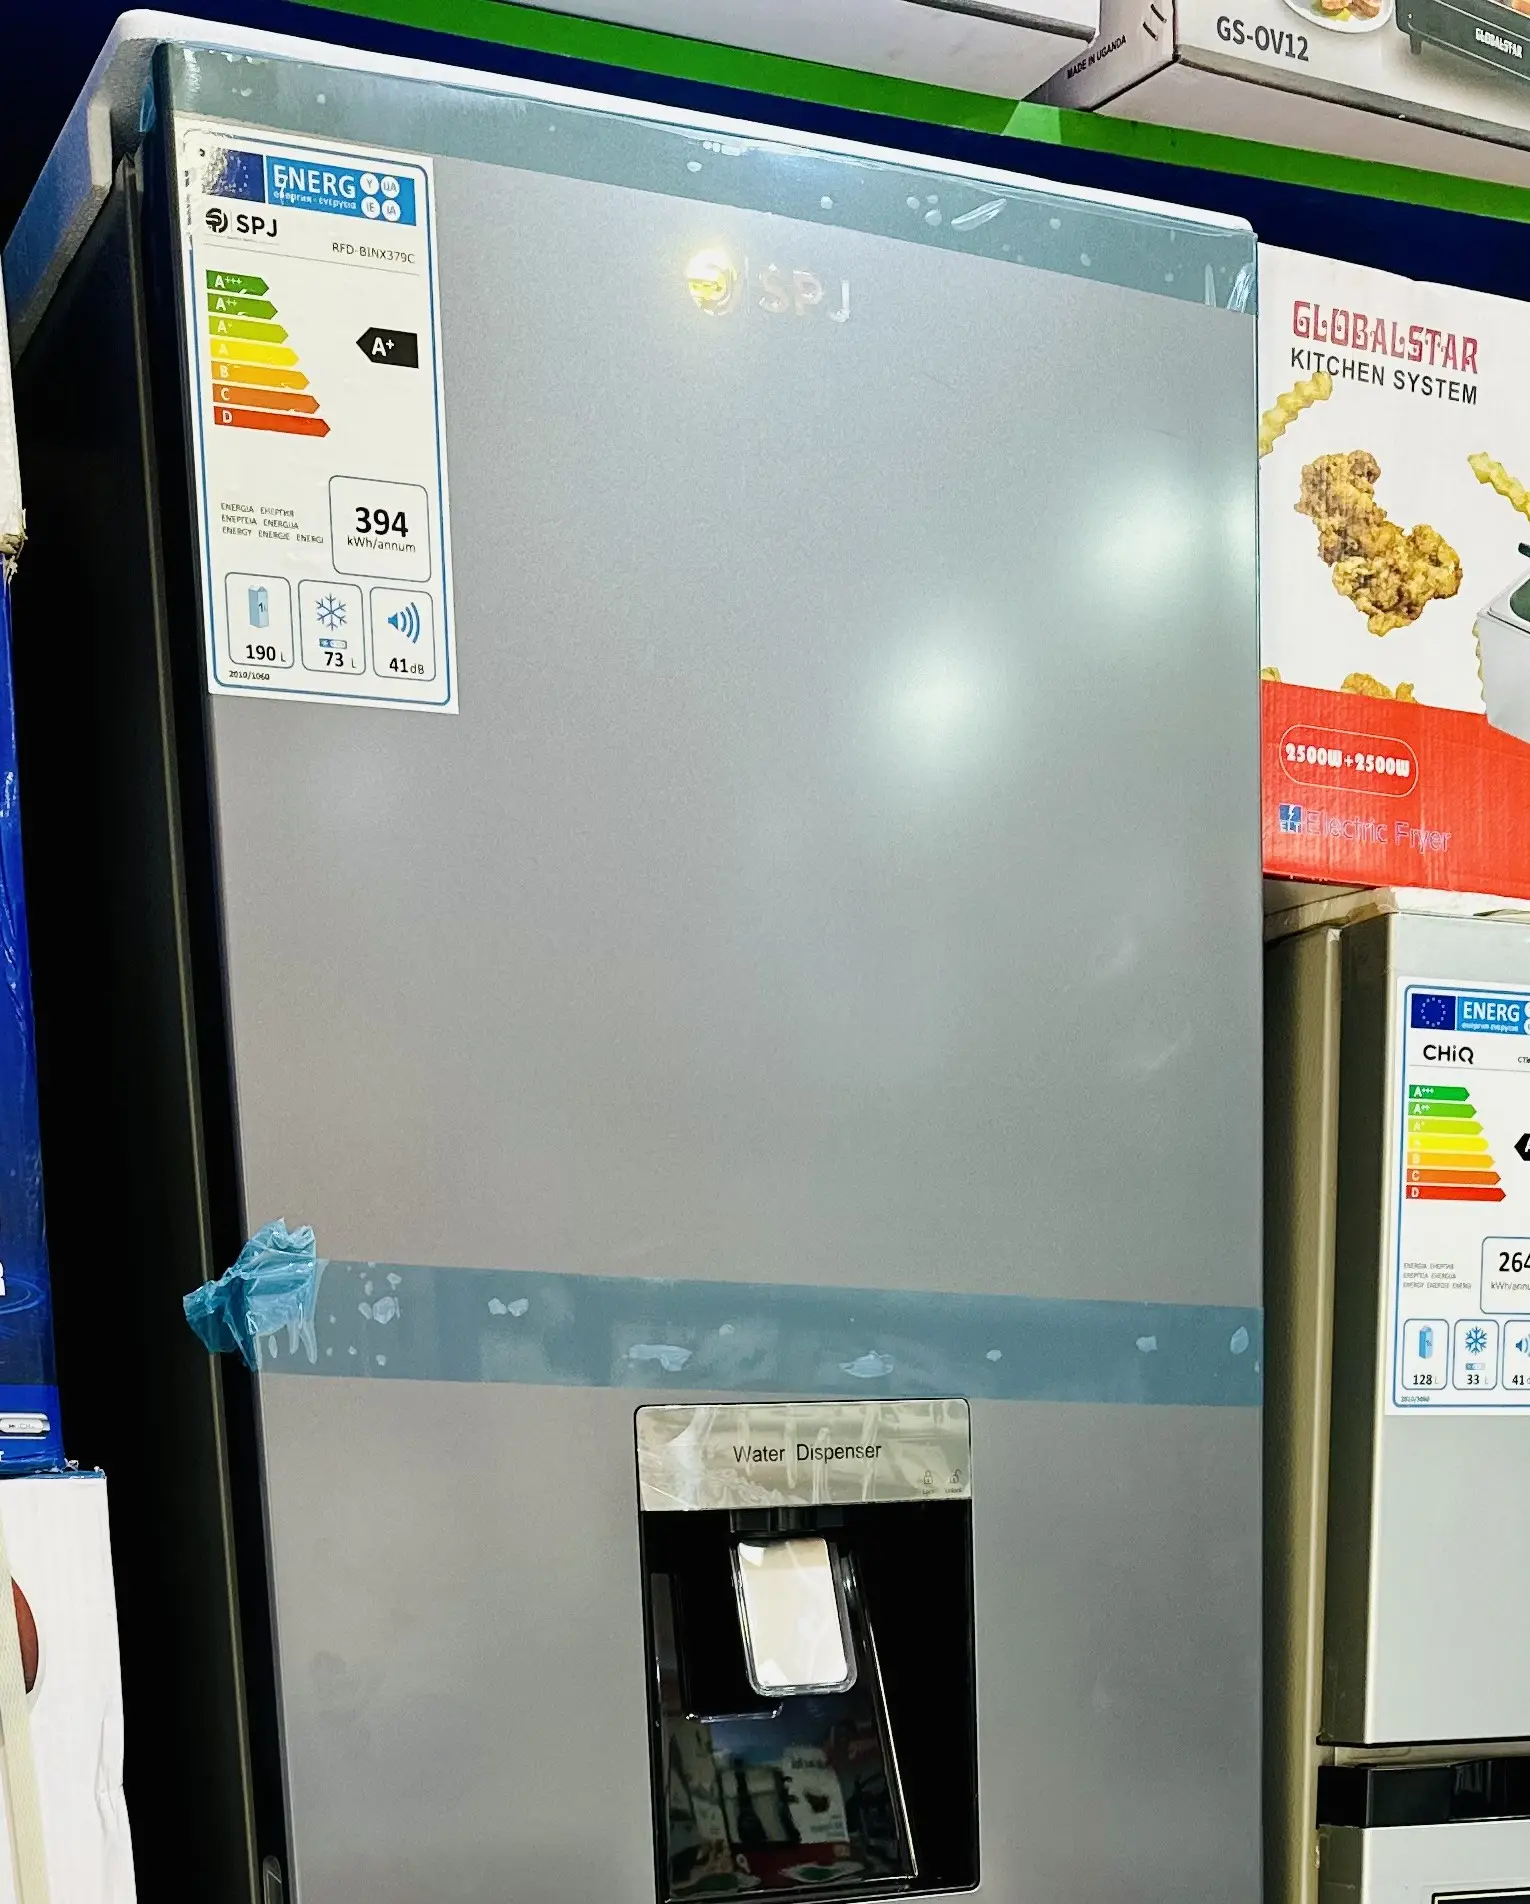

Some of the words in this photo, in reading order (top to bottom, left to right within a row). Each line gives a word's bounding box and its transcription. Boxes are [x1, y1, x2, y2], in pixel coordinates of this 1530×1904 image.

[1216, 15, 1309, 62] GS-OV12
[1066, 59, 1087, 79] MADE
[1087, 53, 1096, 67] IN
[1096, 34, 1127, 61] UGANDA
[272, 164, 356, 199] ENERG
[236, 213, 278, 238] SPJ
[332, 242, 416, 265] RFD-BINX379C
[371, 336, 395, 357] A+
[1292, 300, 1479, 375] GLOBALSTAR
[219, 364, 229, 379] B
[1291, 347, 1385, 387] KITCHEN
[1393, 370, 1478, 405] SYSTEM
[220, 387, 230, 401] C
[222, 409, 233, 424] D
[355, 506, 409, 538] 394
[347, 535, 416, 553] kWh/annum
[245, 644, 277, 662] 190
[323, 650, 345, 668] 73
[1285, 742, 1410, 778] 2500W+2500W
[1305, 809, 1388, 845] Electric
[1394, 820, 1451, 854] Fryer
[1463, 1000, 1520, 1023] ENERG
[1411, 1170, 1420, 1181] C
[1410, 1187, 1420, 1198] D
[1412, 1374, 1433, 1385] 128
[1466, 1374, 1480, 1385] 33
[733, 1445, 786, 1463] Water
[796, 1442, 882, 1467] Dispenser
